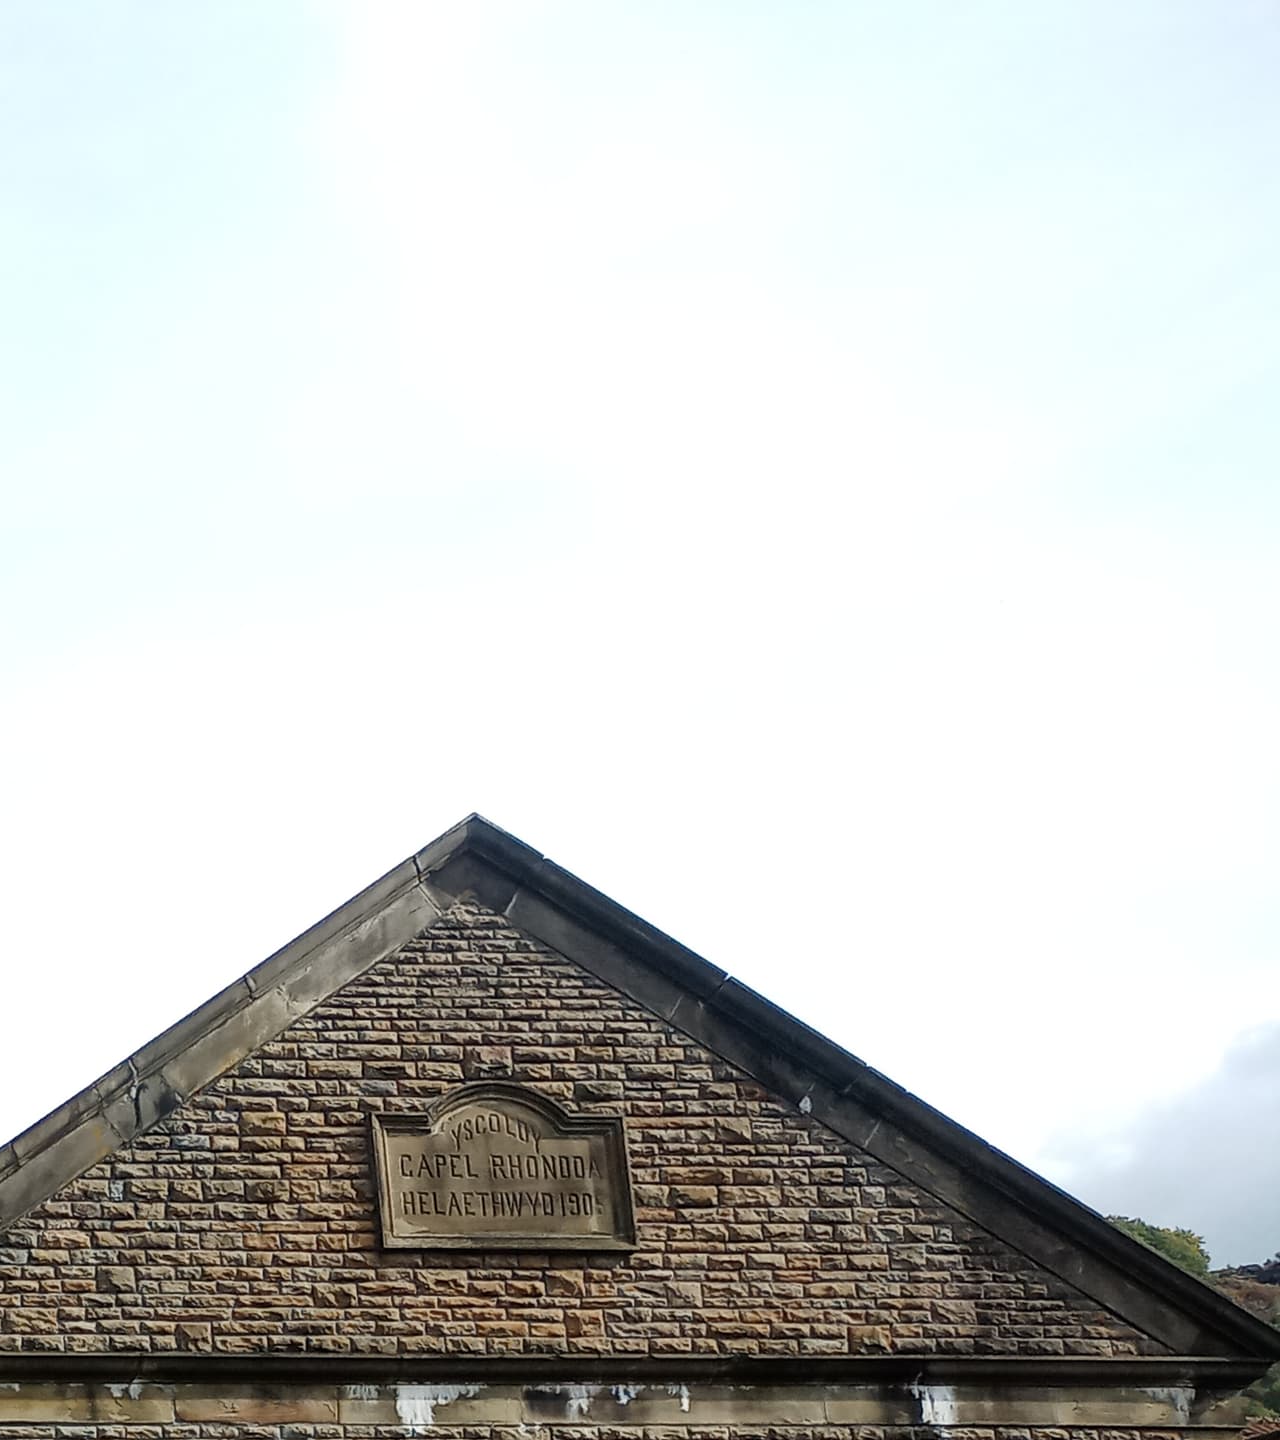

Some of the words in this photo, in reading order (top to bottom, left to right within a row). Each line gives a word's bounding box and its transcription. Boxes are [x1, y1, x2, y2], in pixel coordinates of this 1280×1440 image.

[400, 1154, 479, 1178] CAPEL
[490, 1154, 603, 1179] RHONDDA
[401, 1191, 554, 1216] HELAETHWYD
